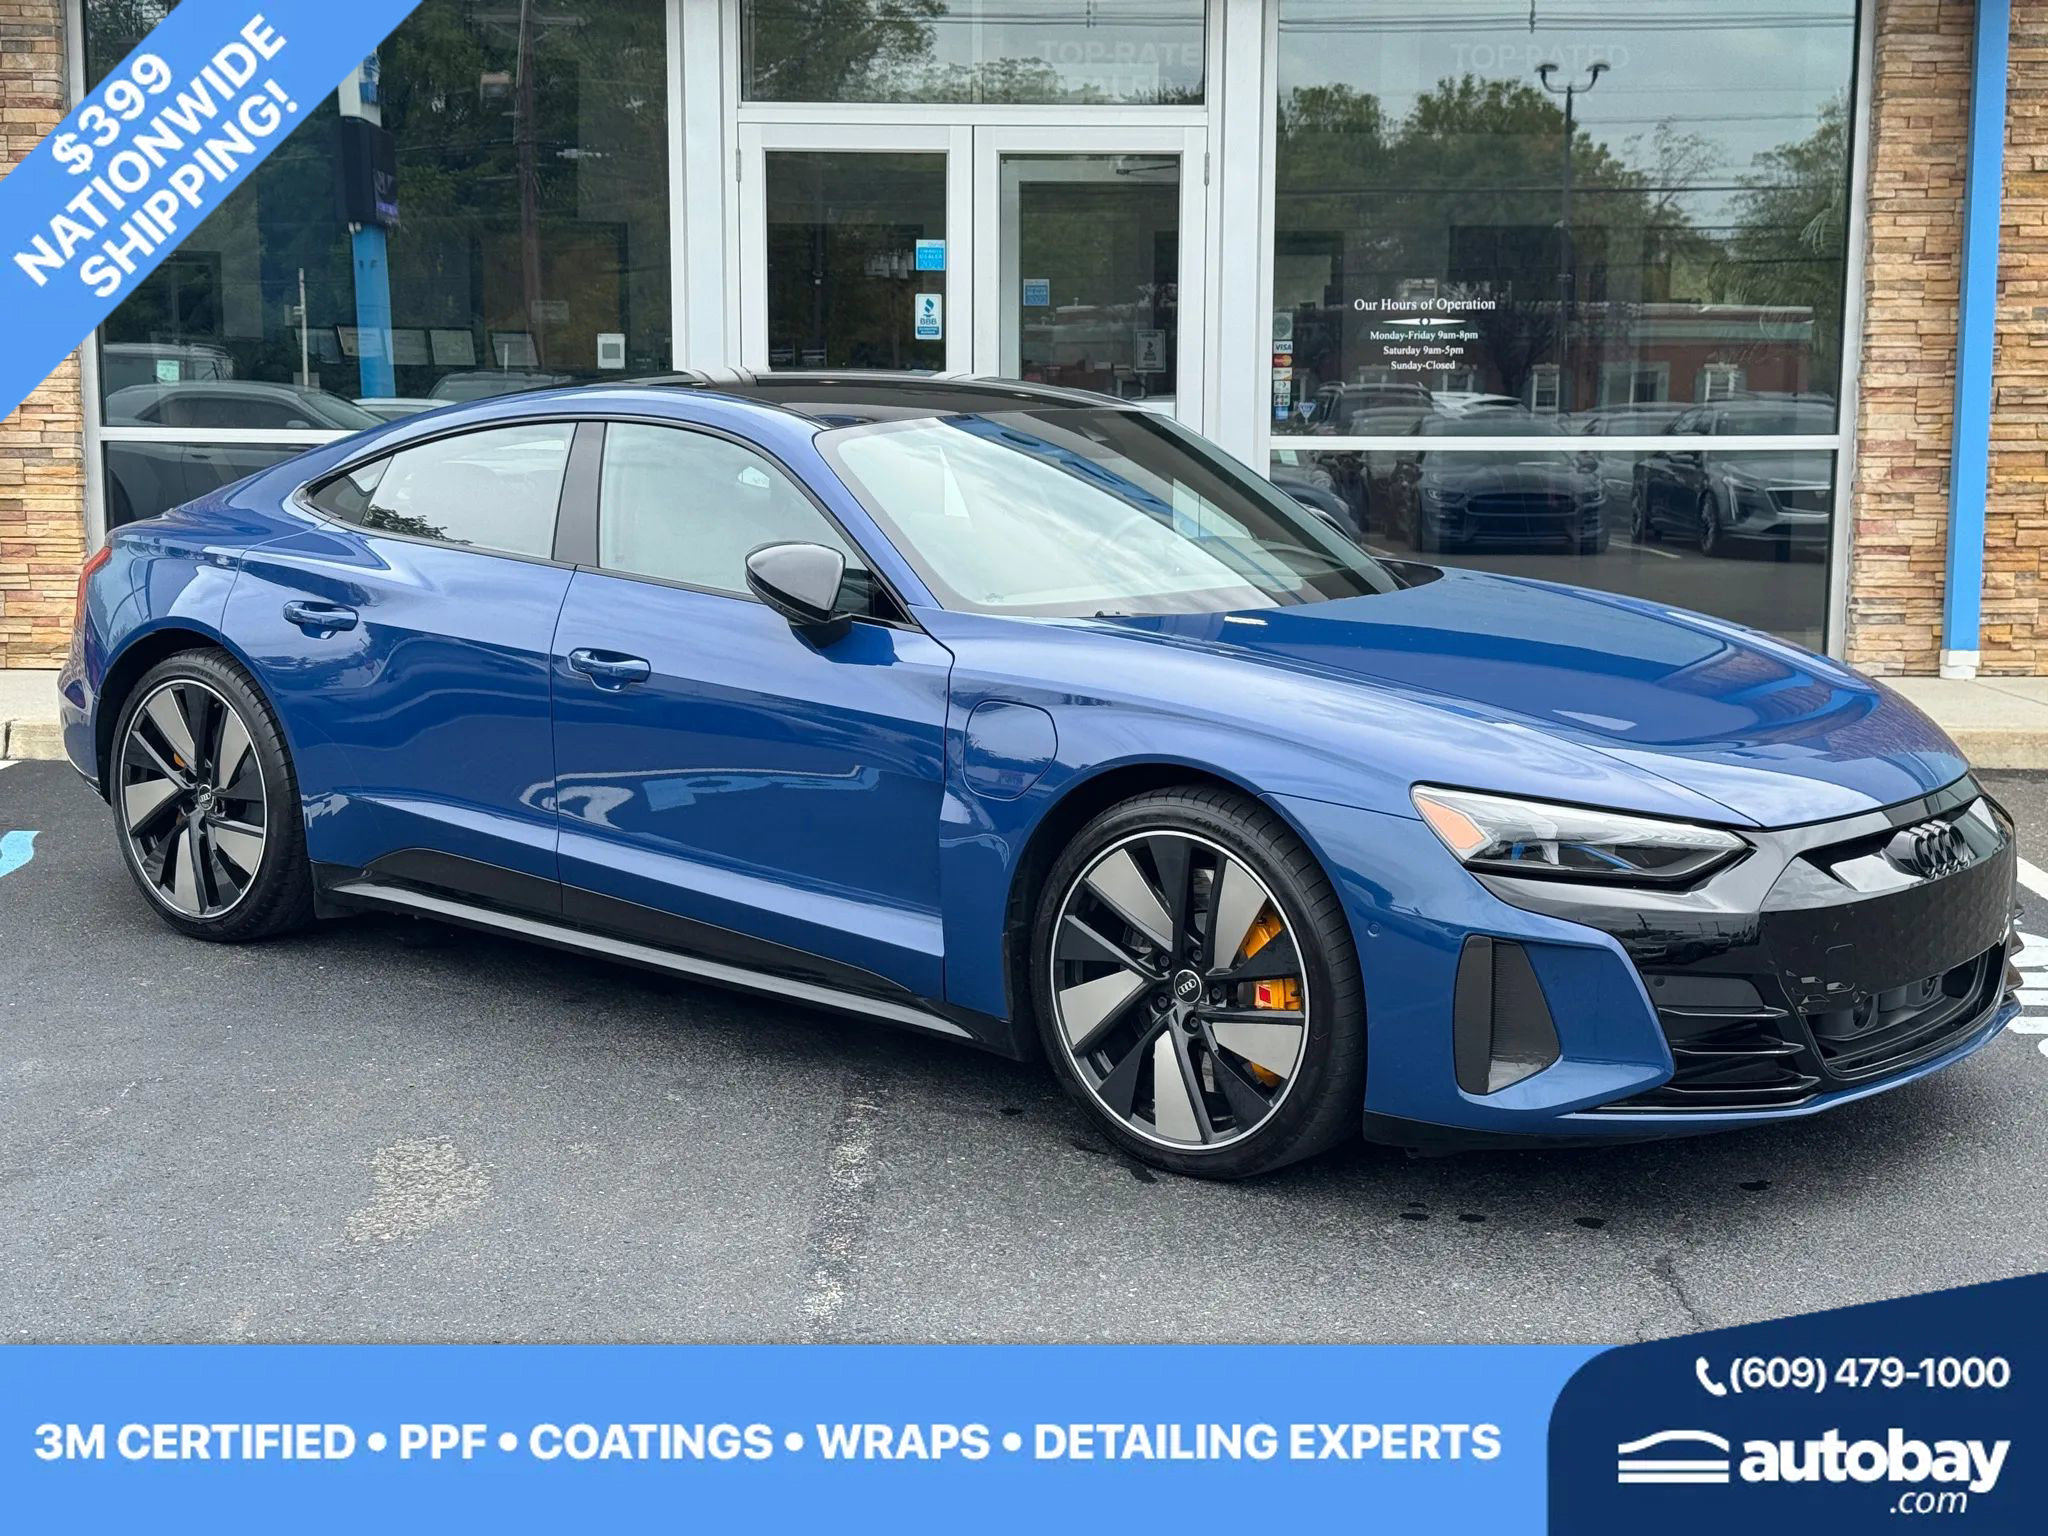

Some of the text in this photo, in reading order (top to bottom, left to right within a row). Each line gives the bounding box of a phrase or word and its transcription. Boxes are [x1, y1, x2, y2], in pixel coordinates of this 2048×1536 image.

[1354, 297, 1496, 313] Our Hours of Operation
[1370, 330, 1479, 342] Monday-Friday 9am-8pm
[1275, 343, 1292, 351] VISA
[1383, 345, 1464, 357] Saturday 9am-5pm
[1390, 360, 1456, 372] Sunday-Closed
